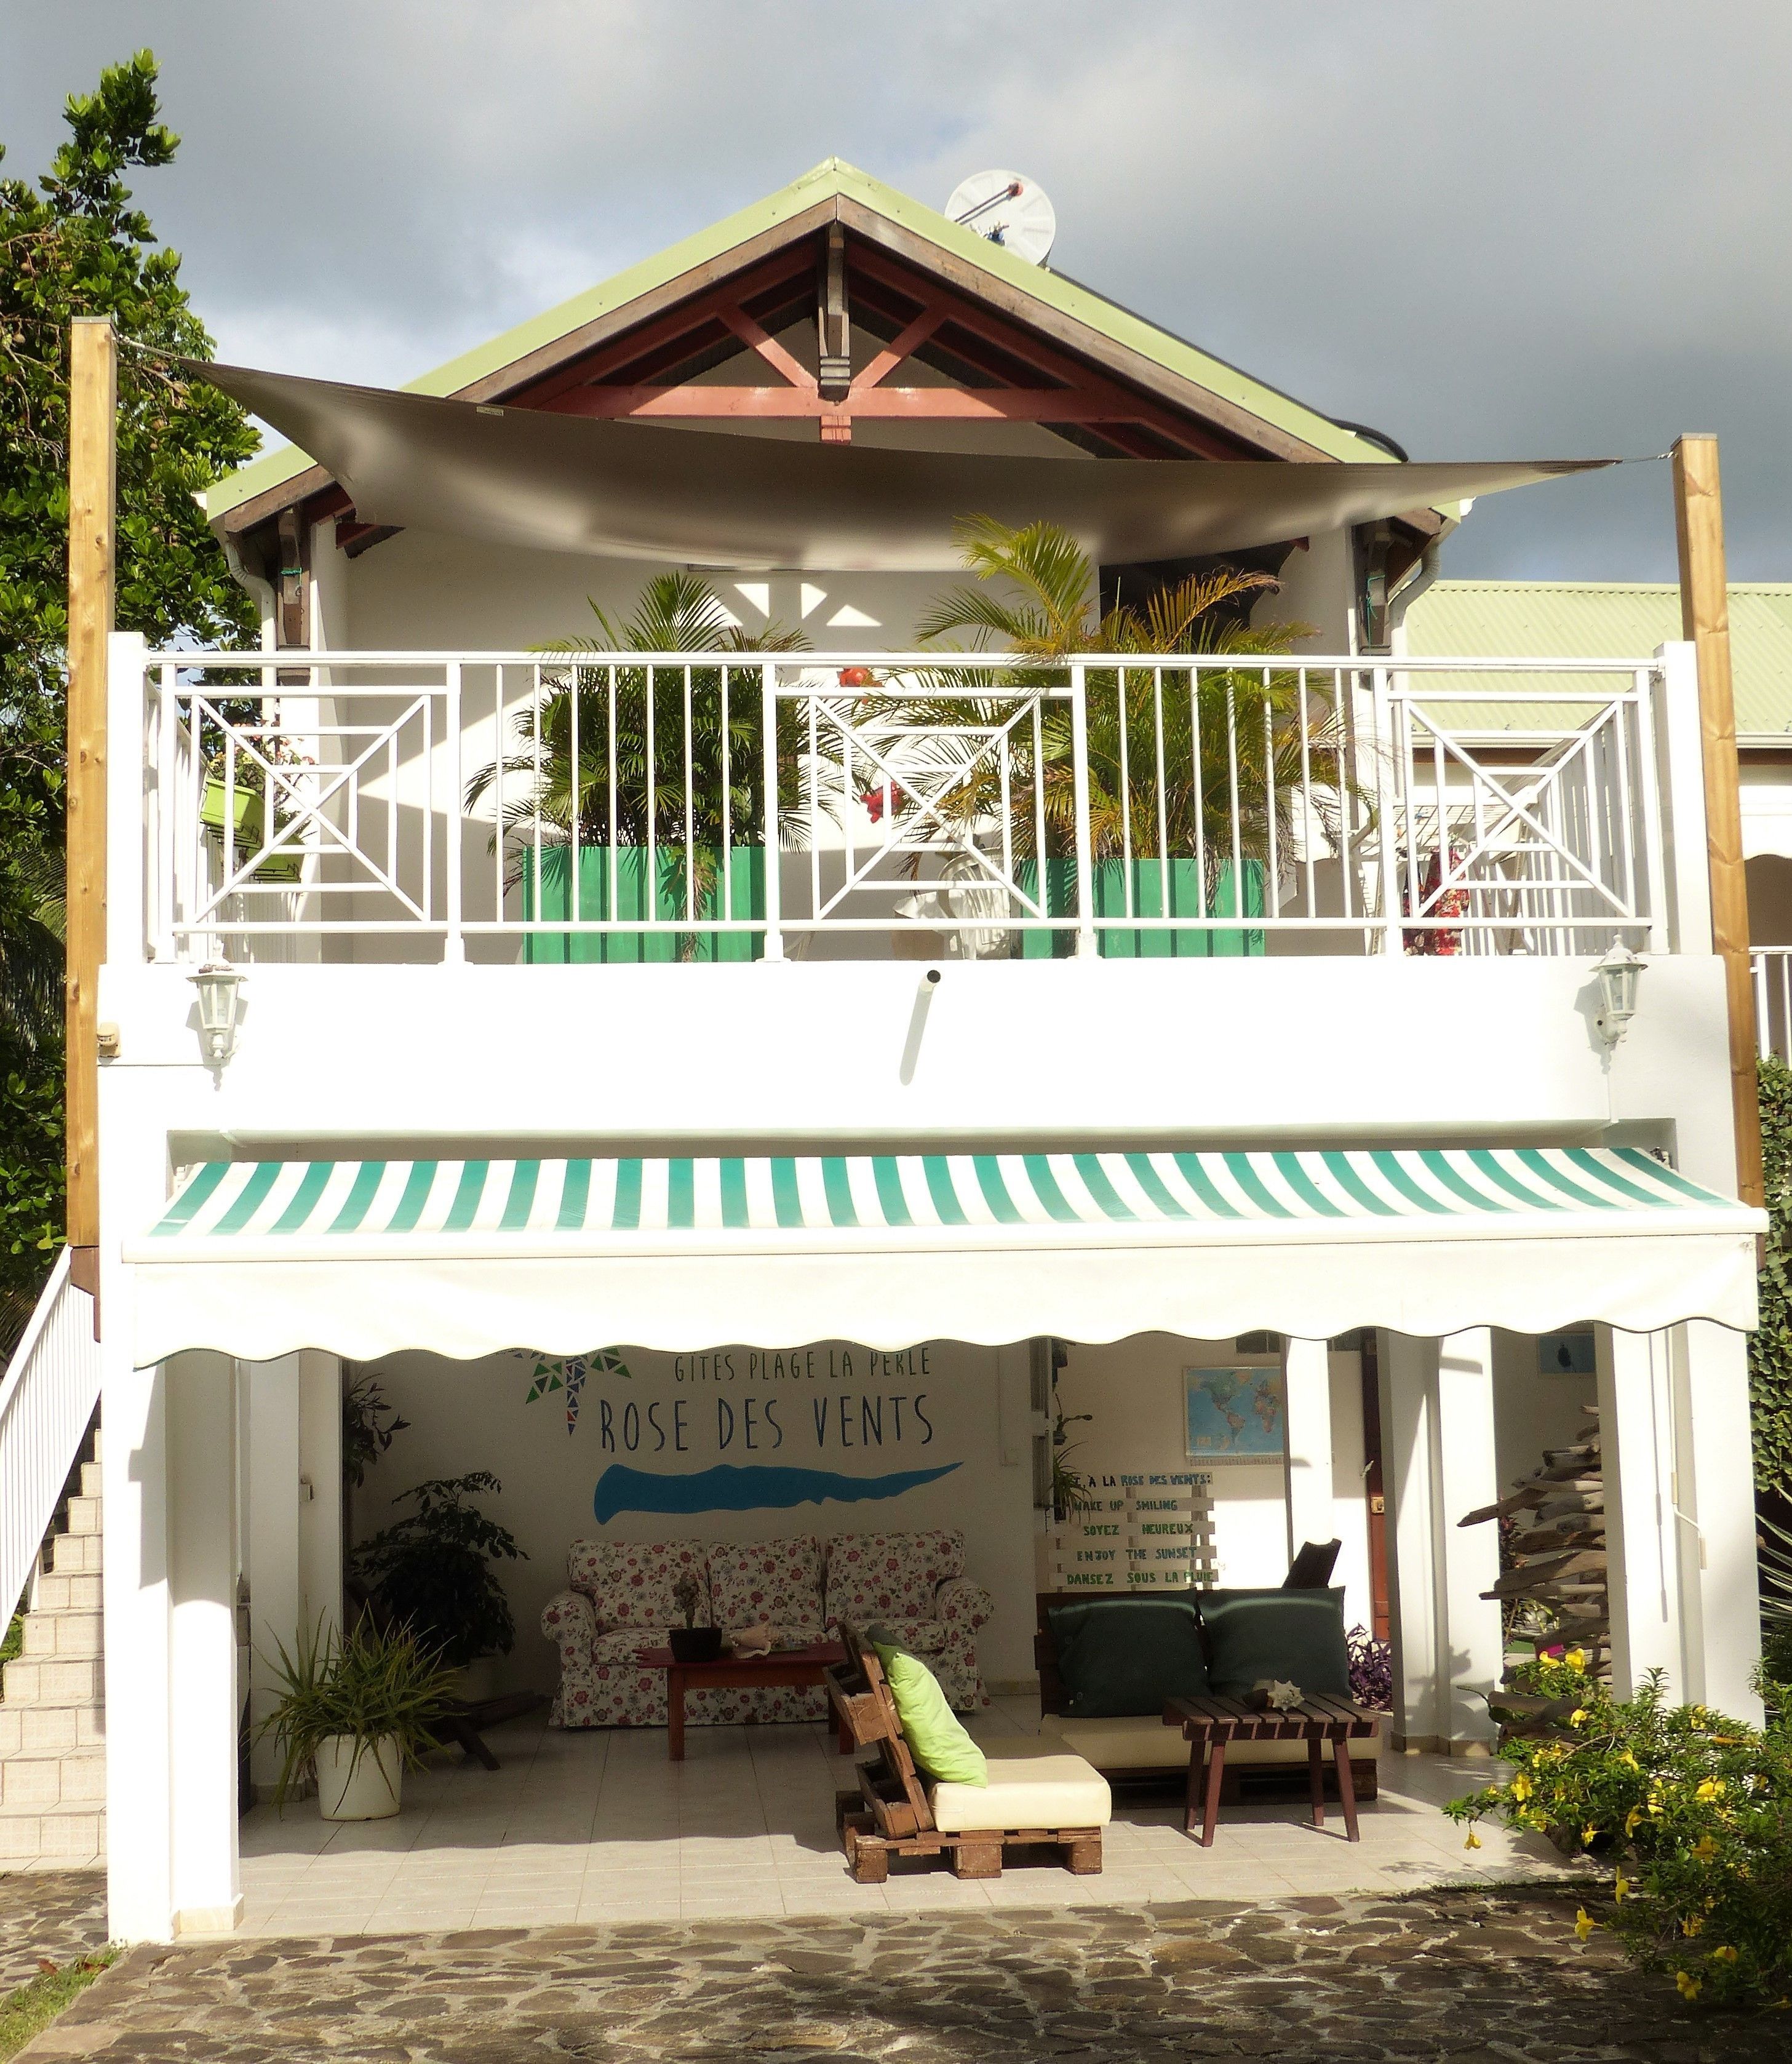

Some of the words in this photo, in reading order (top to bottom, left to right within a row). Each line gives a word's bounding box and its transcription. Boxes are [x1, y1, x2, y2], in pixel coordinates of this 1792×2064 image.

[675, 1354, 735, 1382] GITES
[750, 1352, 814, 1380] PLAGE
[830, 1350, 853, 1377] LA
[870, 1347, 930, 1376] PERLE
[600, 1399, 688, 1452] ROSE
[718, 1397, 783, 1449] DES
[813, 1394, 933, 1447] VENTS
[1102, 1476, 1116, 1487] LA
[1120, 1475, 1144, 1486] ROSE
[1149, 1475, 1168, 1486] DES
[1110, 1500, 1124, 1511] UP
[1136, 1499, 1178, 1511] SMILING
[1084, 1524, 1120, 1536] SOYEZ
[1142, 1523, 1193, 1535] HEUREUX
[1077, 1549, 1116, 1561] ENJOY
[1125, 1548, 1147, 1560] THE
[1155, 1546, 1197, 1560] SUNSET
[1067, 1572, 1114, 1585] DANSEZ
[1127, 1572, 1157, 1584] SOUS
[1165, 1572, 1179, 1583] LA
